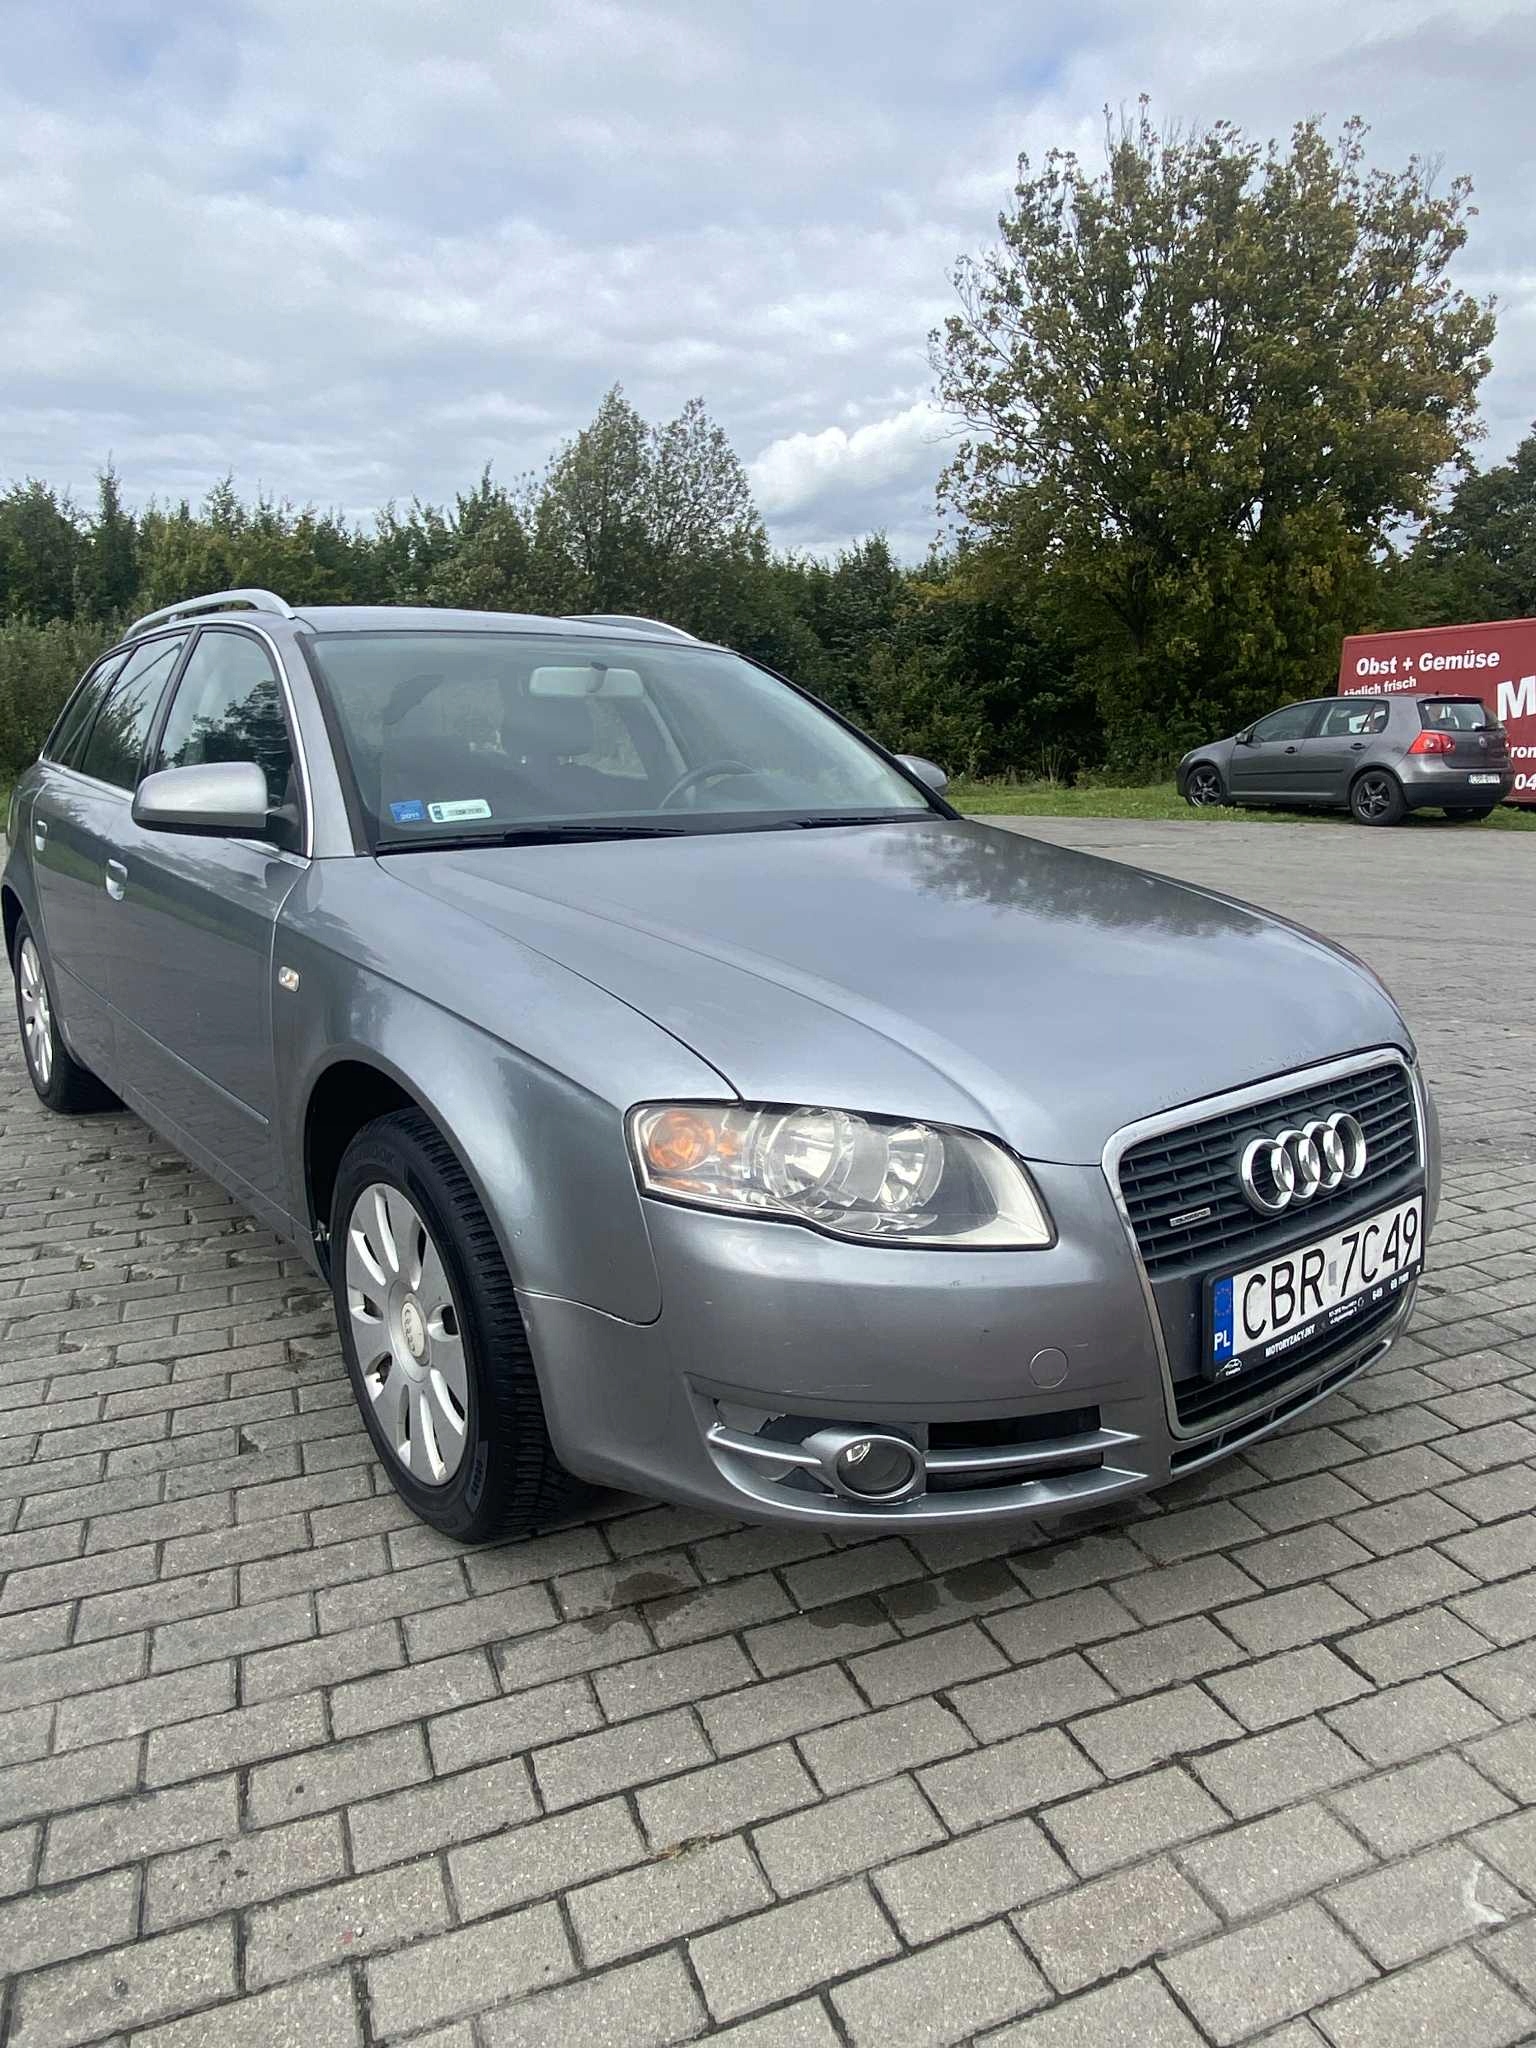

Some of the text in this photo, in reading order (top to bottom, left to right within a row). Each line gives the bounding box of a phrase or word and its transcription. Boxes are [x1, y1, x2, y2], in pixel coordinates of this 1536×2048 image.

[1356, 655, 1397, 676] Obst
[1419, 650, 1500, 672] Gemüse
[1383, 676, 1417, 692] frisch
[1243, 1207, 1418, 1340] CBR 7C49
[1214, 1331, 1231, 1351] PL
